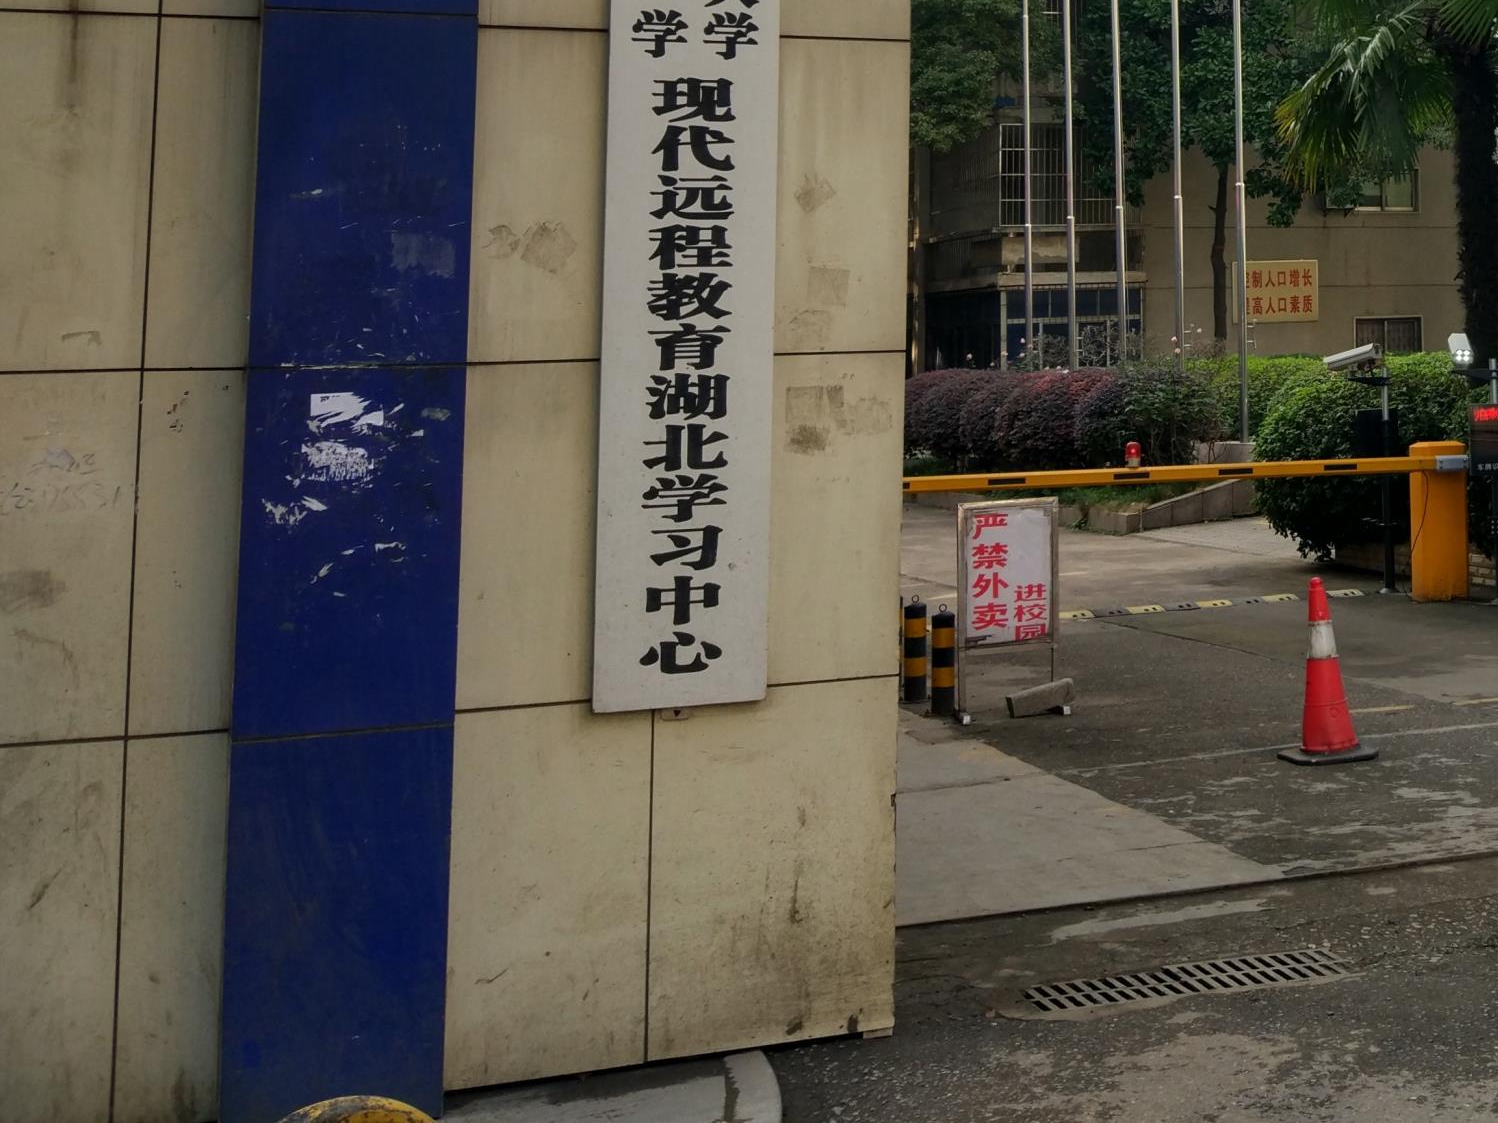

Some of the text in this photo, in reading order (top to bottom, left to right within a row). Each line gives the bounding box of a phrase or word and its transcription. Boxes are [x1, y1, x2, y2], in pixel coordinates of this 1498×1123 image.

[640, 77, 737, 675] 现代远程教育湖北学习中心
[972, 513, 1009, 631] 严禁外卖
[1014, 583, 1048, 641] 进校园
